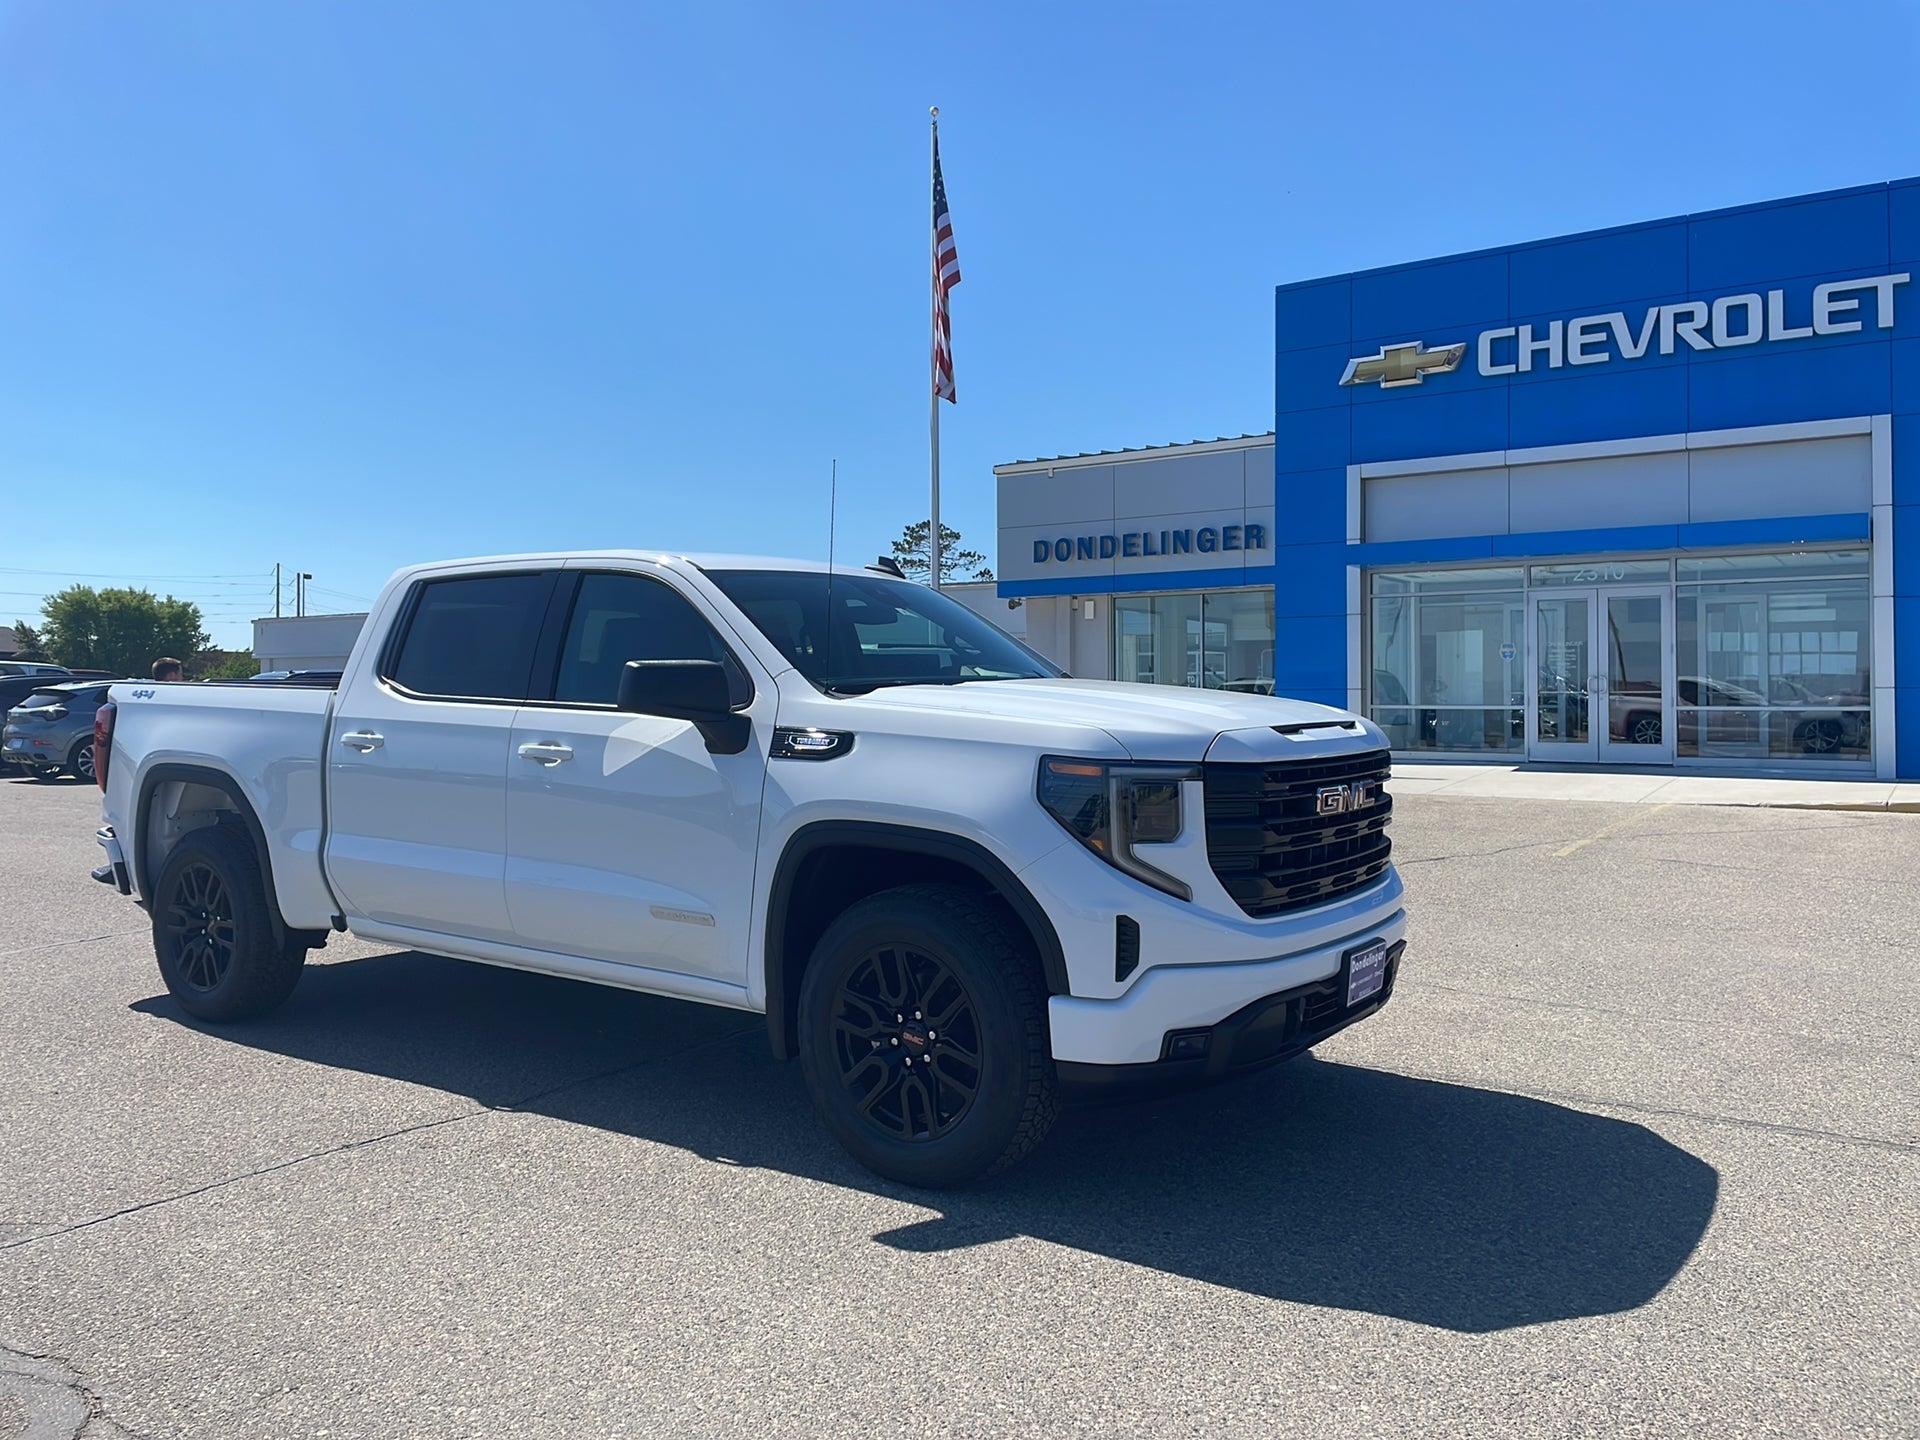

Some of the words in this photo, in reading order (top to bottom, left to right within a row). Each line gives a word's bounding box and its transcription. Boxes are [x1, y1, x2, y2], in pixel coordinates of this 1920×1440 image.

[1478, 272, 1911, 377] CHEVROLET
[1033, 524, 1266, 563] DONDELINGER
[1573, 566, 1625, 582] 2310
[1316, 779, 1376, 816] GMC
